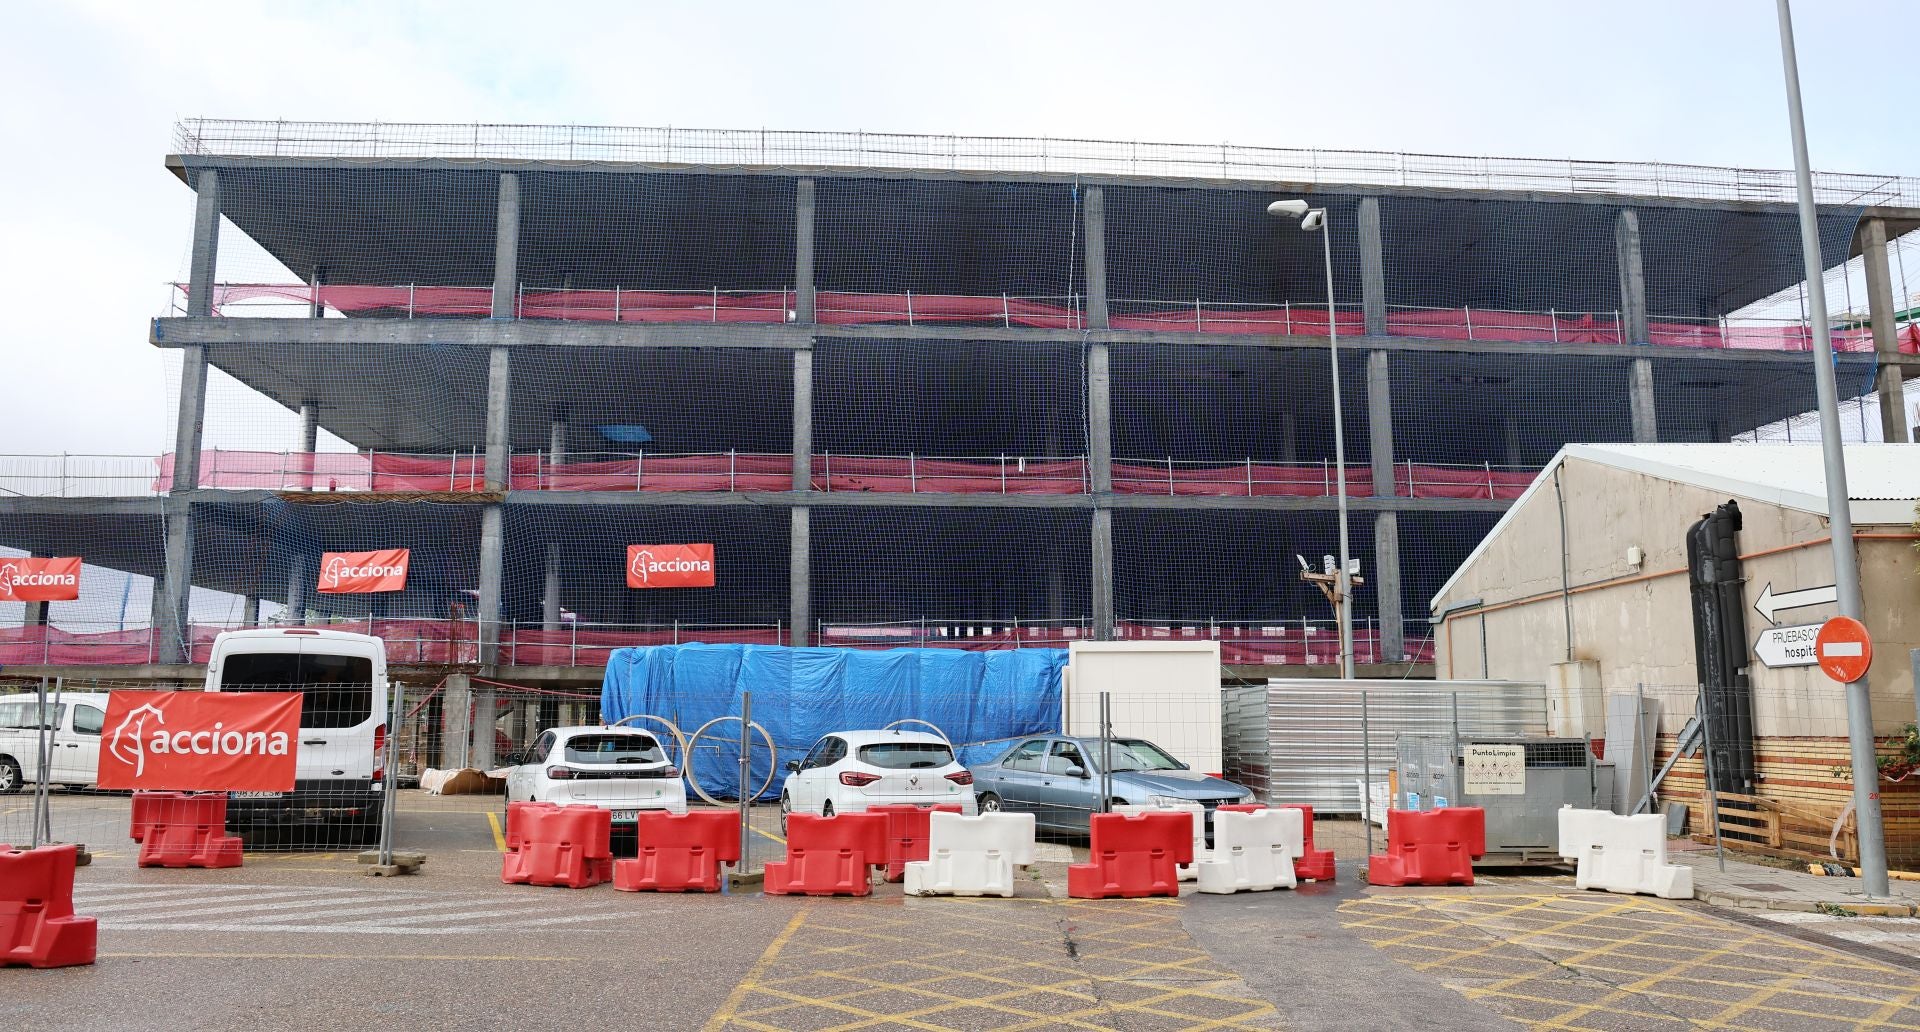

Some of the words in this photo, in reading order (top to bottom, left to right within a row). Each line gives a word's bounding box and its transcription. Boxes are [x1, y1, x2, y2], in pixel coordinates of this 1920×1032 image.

[340, 562, 403, 578] acciona
[648, 557, 711, 572] acciona
[11, 570, 76, 586] acciona
[1785, 645, 1817, 660] hospita
[150, 721, 290, 756] acciona
